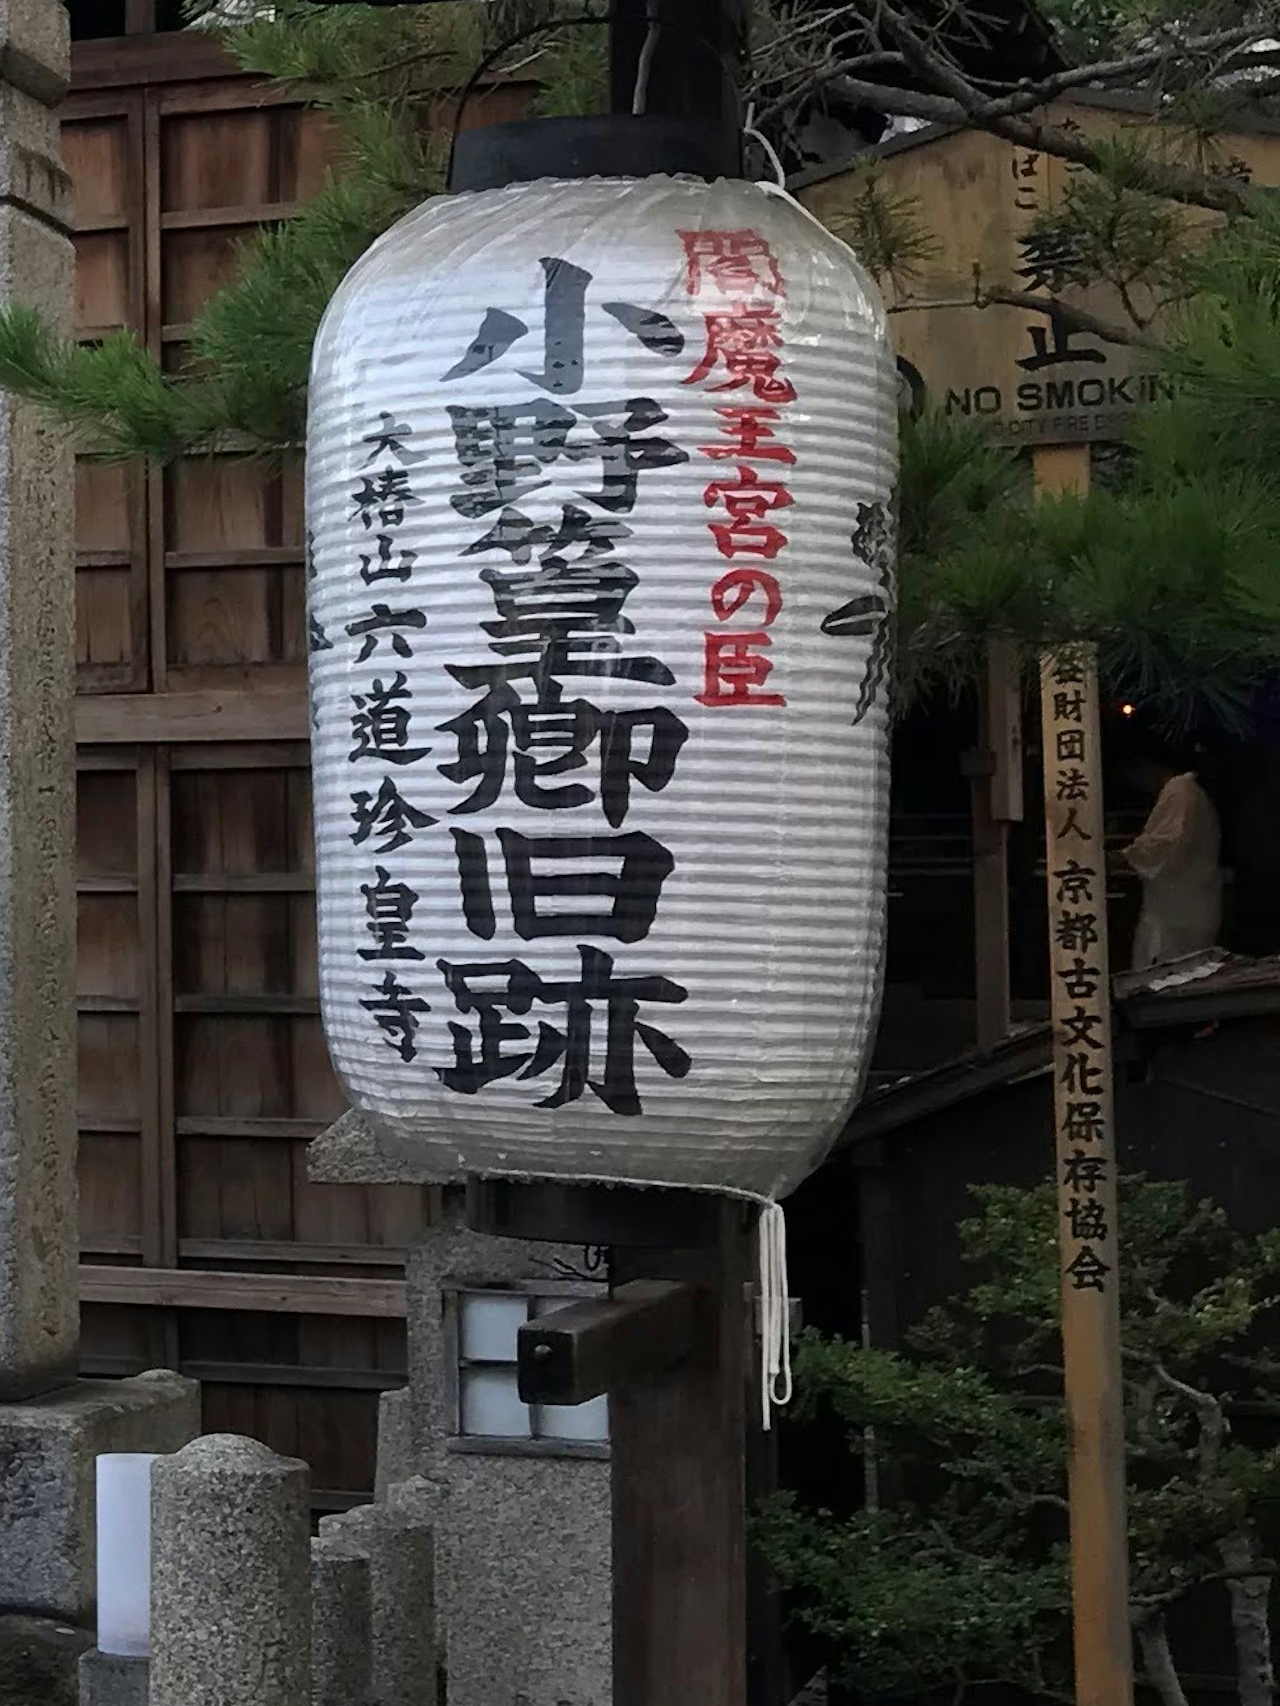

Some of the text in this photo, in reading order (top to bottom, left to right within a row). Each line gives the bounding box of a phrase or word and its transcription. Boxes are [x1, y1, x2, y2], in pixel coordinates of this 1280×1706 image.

[674, 227, 797, 708] 閻魔王宮の臣
[945, 386, 1002, 416] NO
[344, 410, 440, 1062] 大椿山六道珍皇寺
[435, 257, 692, 1115] 小野篁卿旧跡
[1053, 859, 1111, 1293] 京都古文化保存協会
